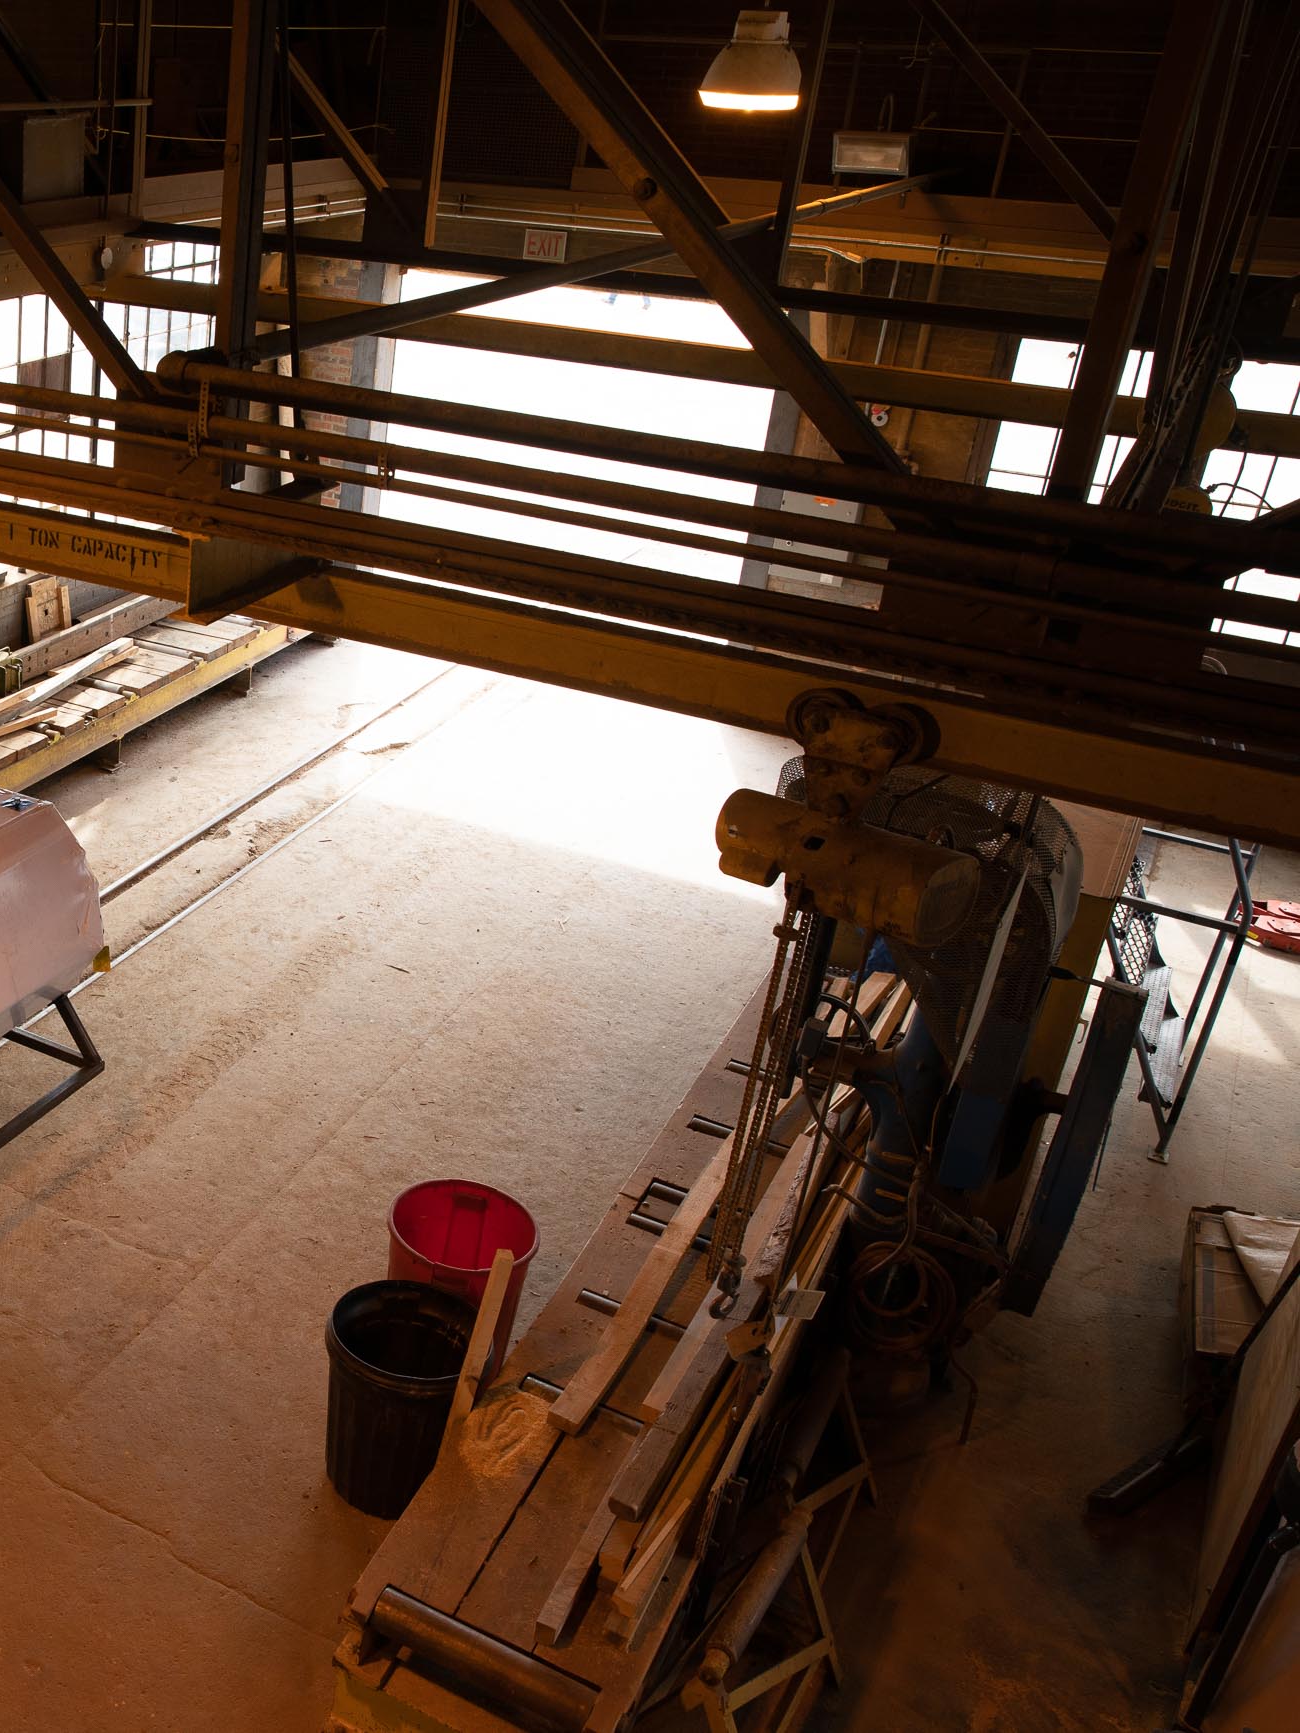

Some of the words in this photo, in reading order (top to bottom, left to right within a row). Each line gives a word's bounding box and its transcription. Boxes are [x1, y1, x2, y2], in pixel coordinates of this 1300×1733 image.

[527, 233, 563, 258] EXIT
[29, 527, 60, 549] TON
[71, 535, 161, 570] CAPACITY
